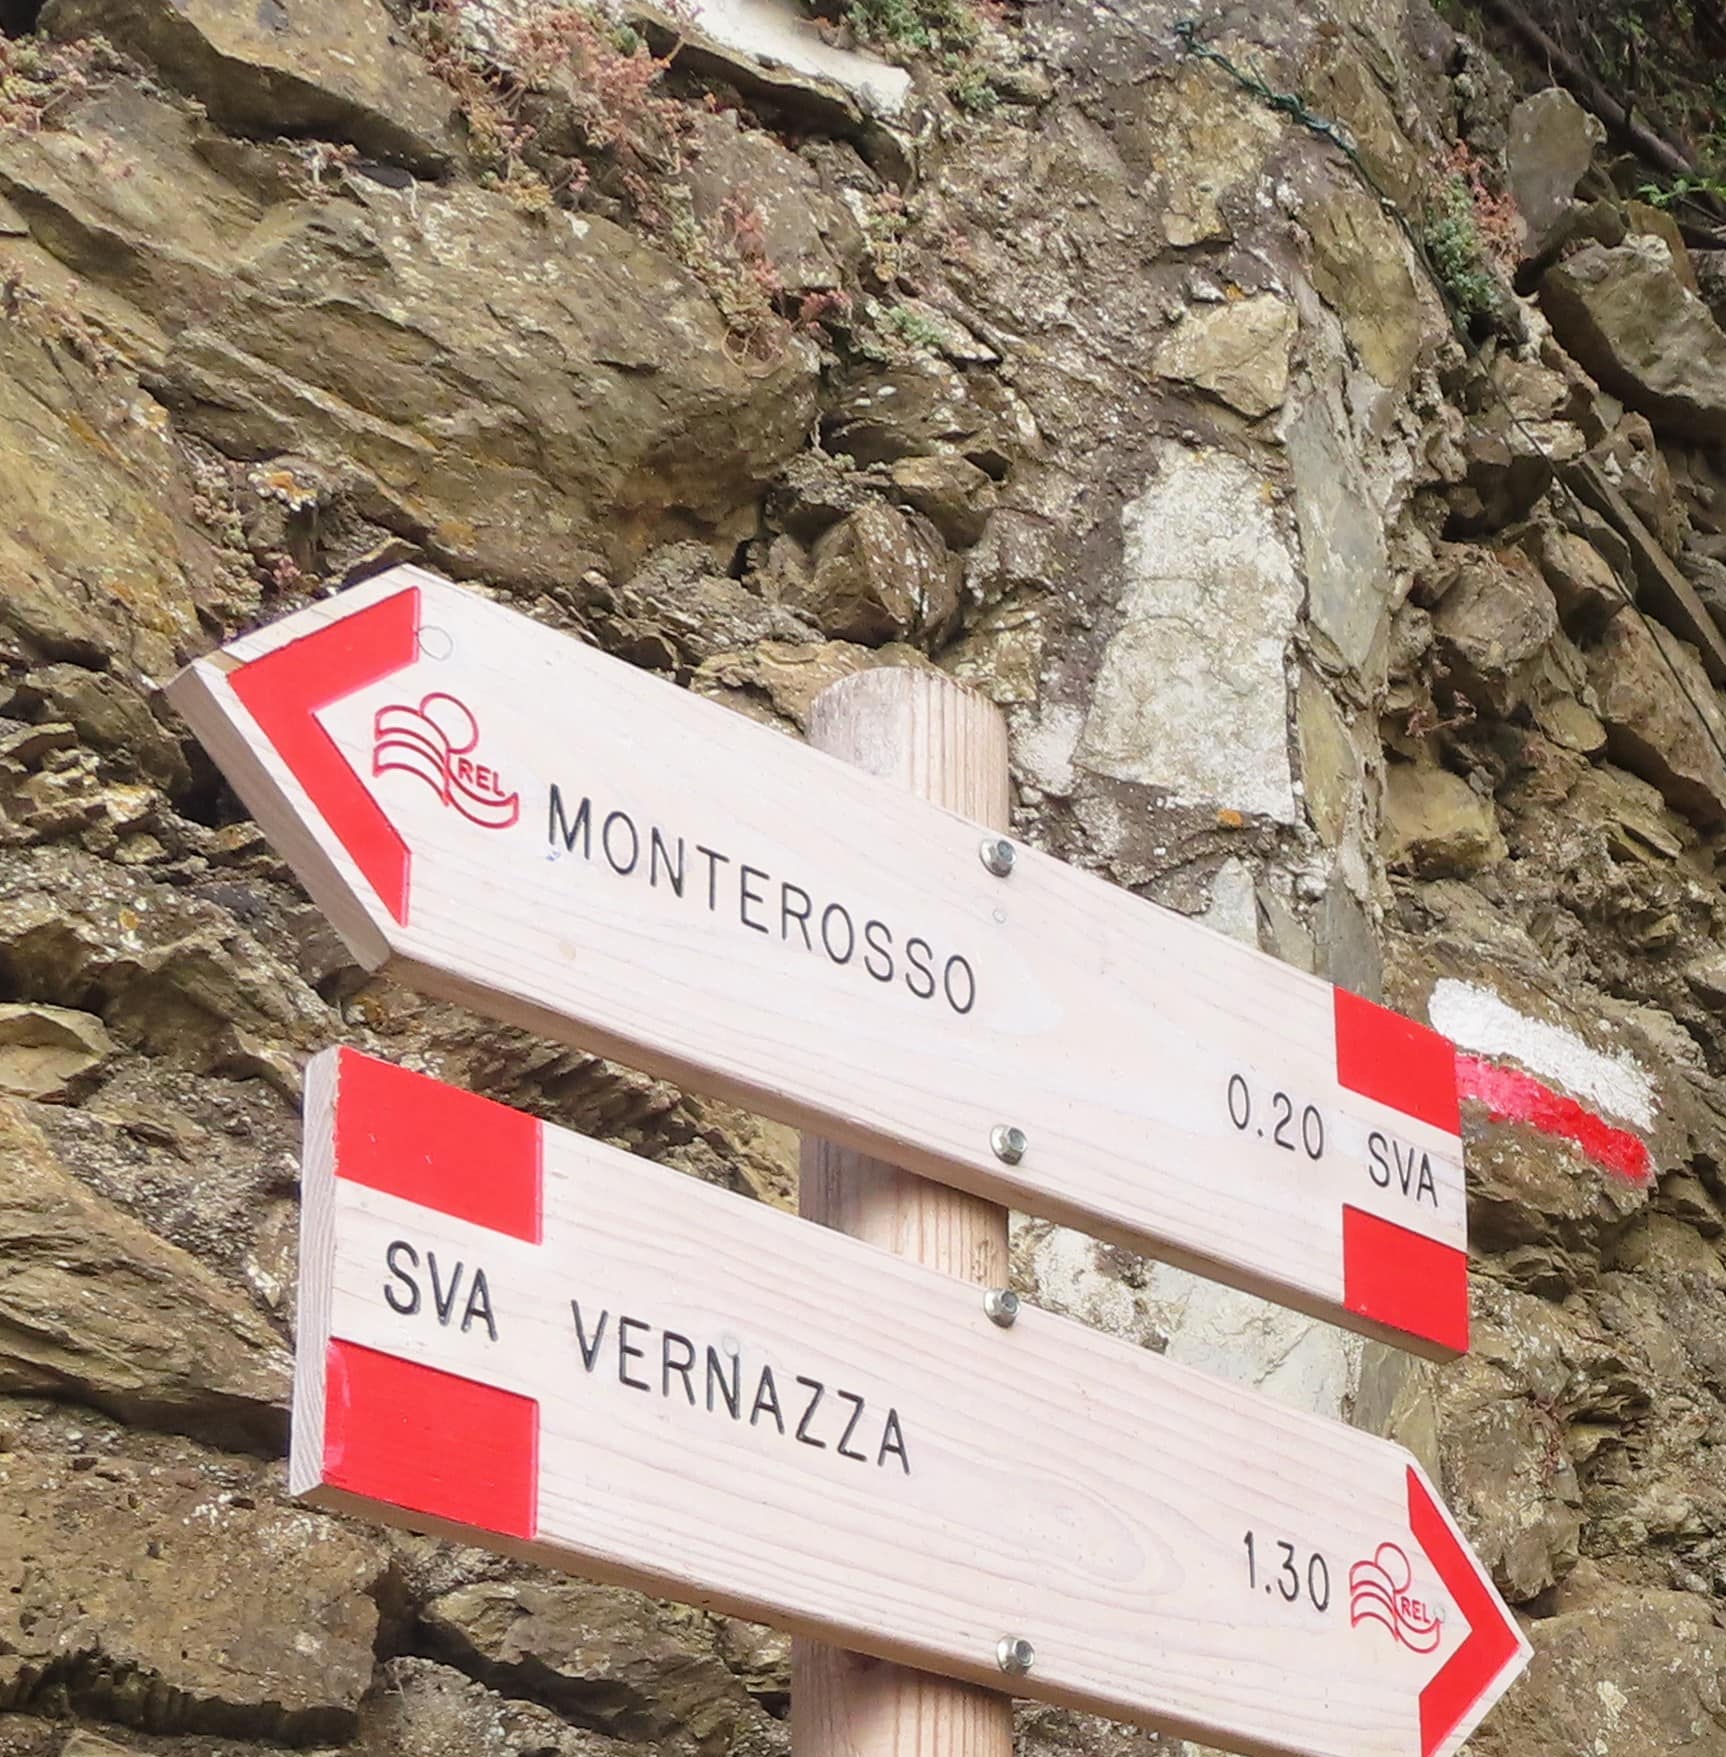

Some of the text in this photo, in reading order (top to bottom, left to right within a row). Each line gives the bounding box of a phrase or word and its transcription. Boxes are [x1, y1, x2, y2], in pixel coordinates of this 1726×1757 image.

[457, 757, 506, 798] REL
[548, 783, 1438, 1208] MONTEROSSO 0.20 SVA
[383, 1239, 1331, 1613] SVA VERNAZZA 1.30
